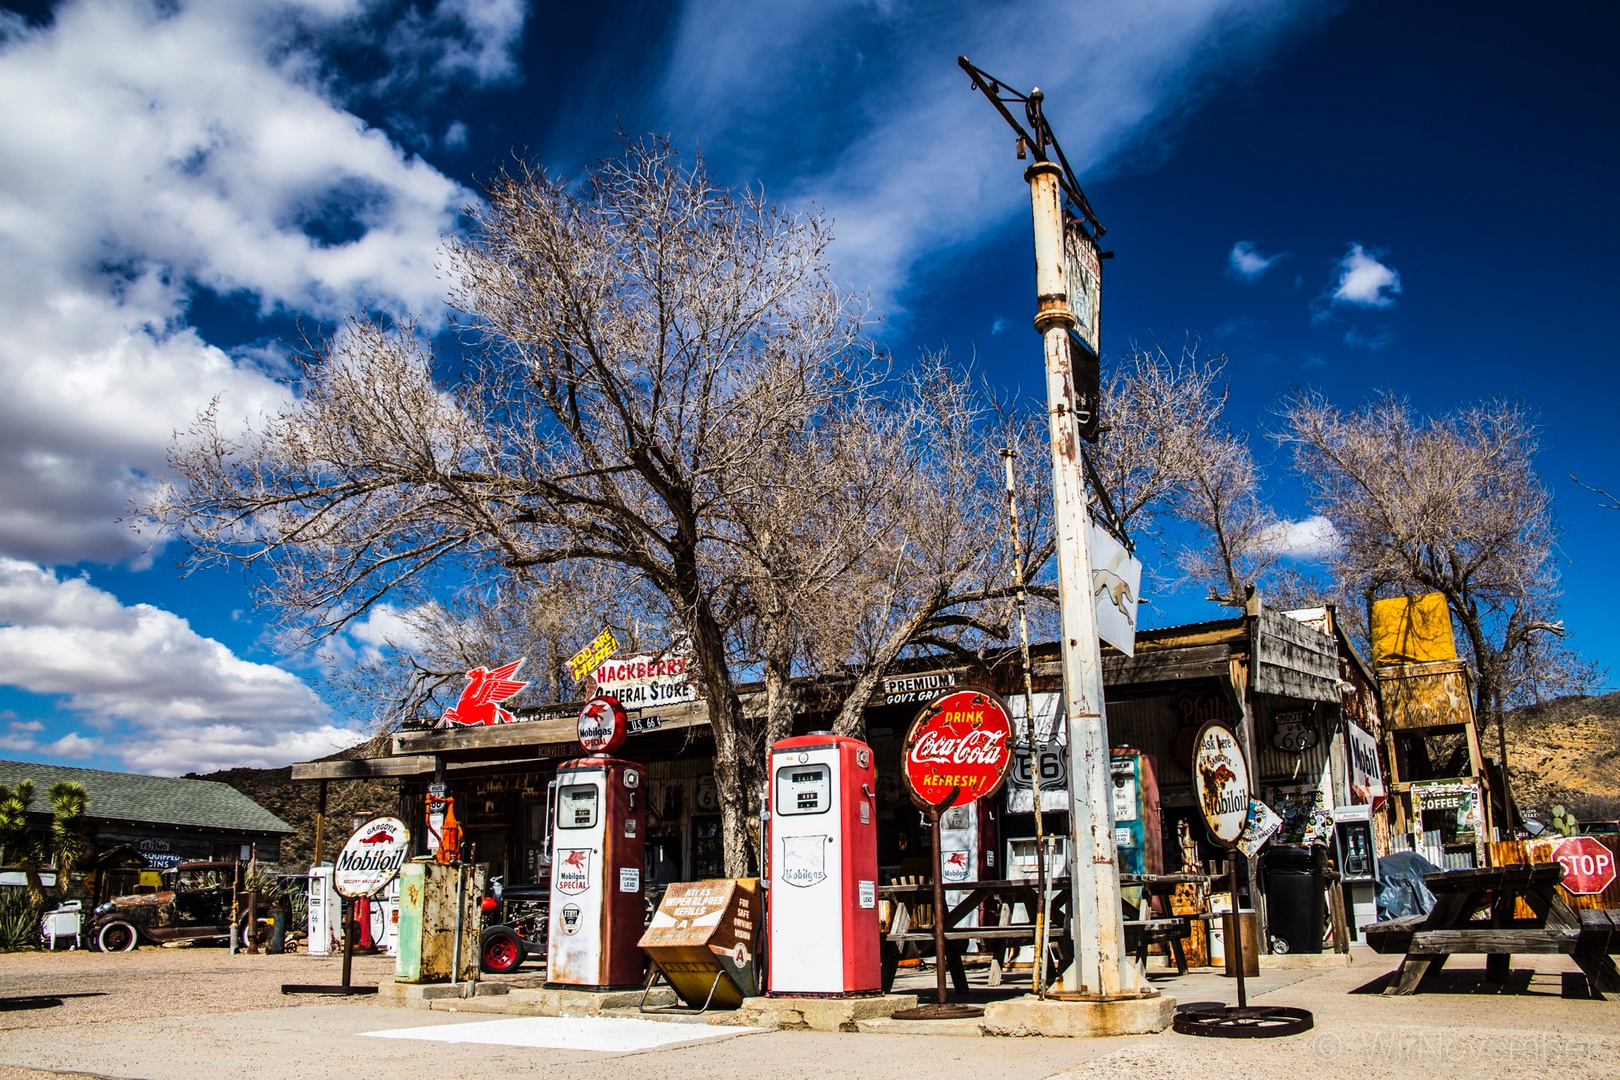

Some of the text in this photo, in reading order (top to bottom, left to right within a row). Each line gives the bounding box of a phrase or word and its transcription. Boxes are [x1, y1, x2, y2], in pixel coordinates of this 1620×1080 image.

[570, 630, 612, 668] YOU ARE
[574, 638, 616, 681] HERE!
[597, 656, 687, 683] HACKBERRY
[888, 674, 950, 693] PREMIUM
[650, 681, 689, 701] STORE
[918, 688, 951, 701] GRA
[646, 718, 656, 729] 66
[945, 711, 984, 723] DRINK
[1279, 713, 1302, 722] ROUT
[580, 726, 612, 739] Mobilgas
[584, 738, 607, 748] SPECIAL
[1201, 738, 1216, 751] Ask
[1282, 731, 1307, 749] 66
[911, 730, 1007, 764] Coca-Cola
[1351, 734, 1380, 780] Mobil
[1020, 753, 1059, 779] 66
[1110, 762, 1130, 770] EGULAR
[1420, 797, 1459, 810] COFFEE
[367, 823, 395, 835] GARGOYLE
[1258, 822, 1278, 840] ANGELES
[337, 849, 404, 871] Mobiloil
[1556, 854, 1609, 876] STOP
[561, 872, 585, 881] Mobilgas
[786, 869, 823, 882] Mobilgas
[945, 870, 968, 878] Mobilgas
[560, 881, 586, 889] SPECIAL
[684, 888, 711, 897] ATLAS
[665, 896, 725, 906] WIPER BLADES
[739, 898, 749, 908] FOR
[673, 906, 707, 916] REFILLS
[737, 908, 750, 919] SAFE
[733, 917, 753, 930] DRIVING
[734, 929, 751, 940] VISION
[736, 948, 744, 962] A
